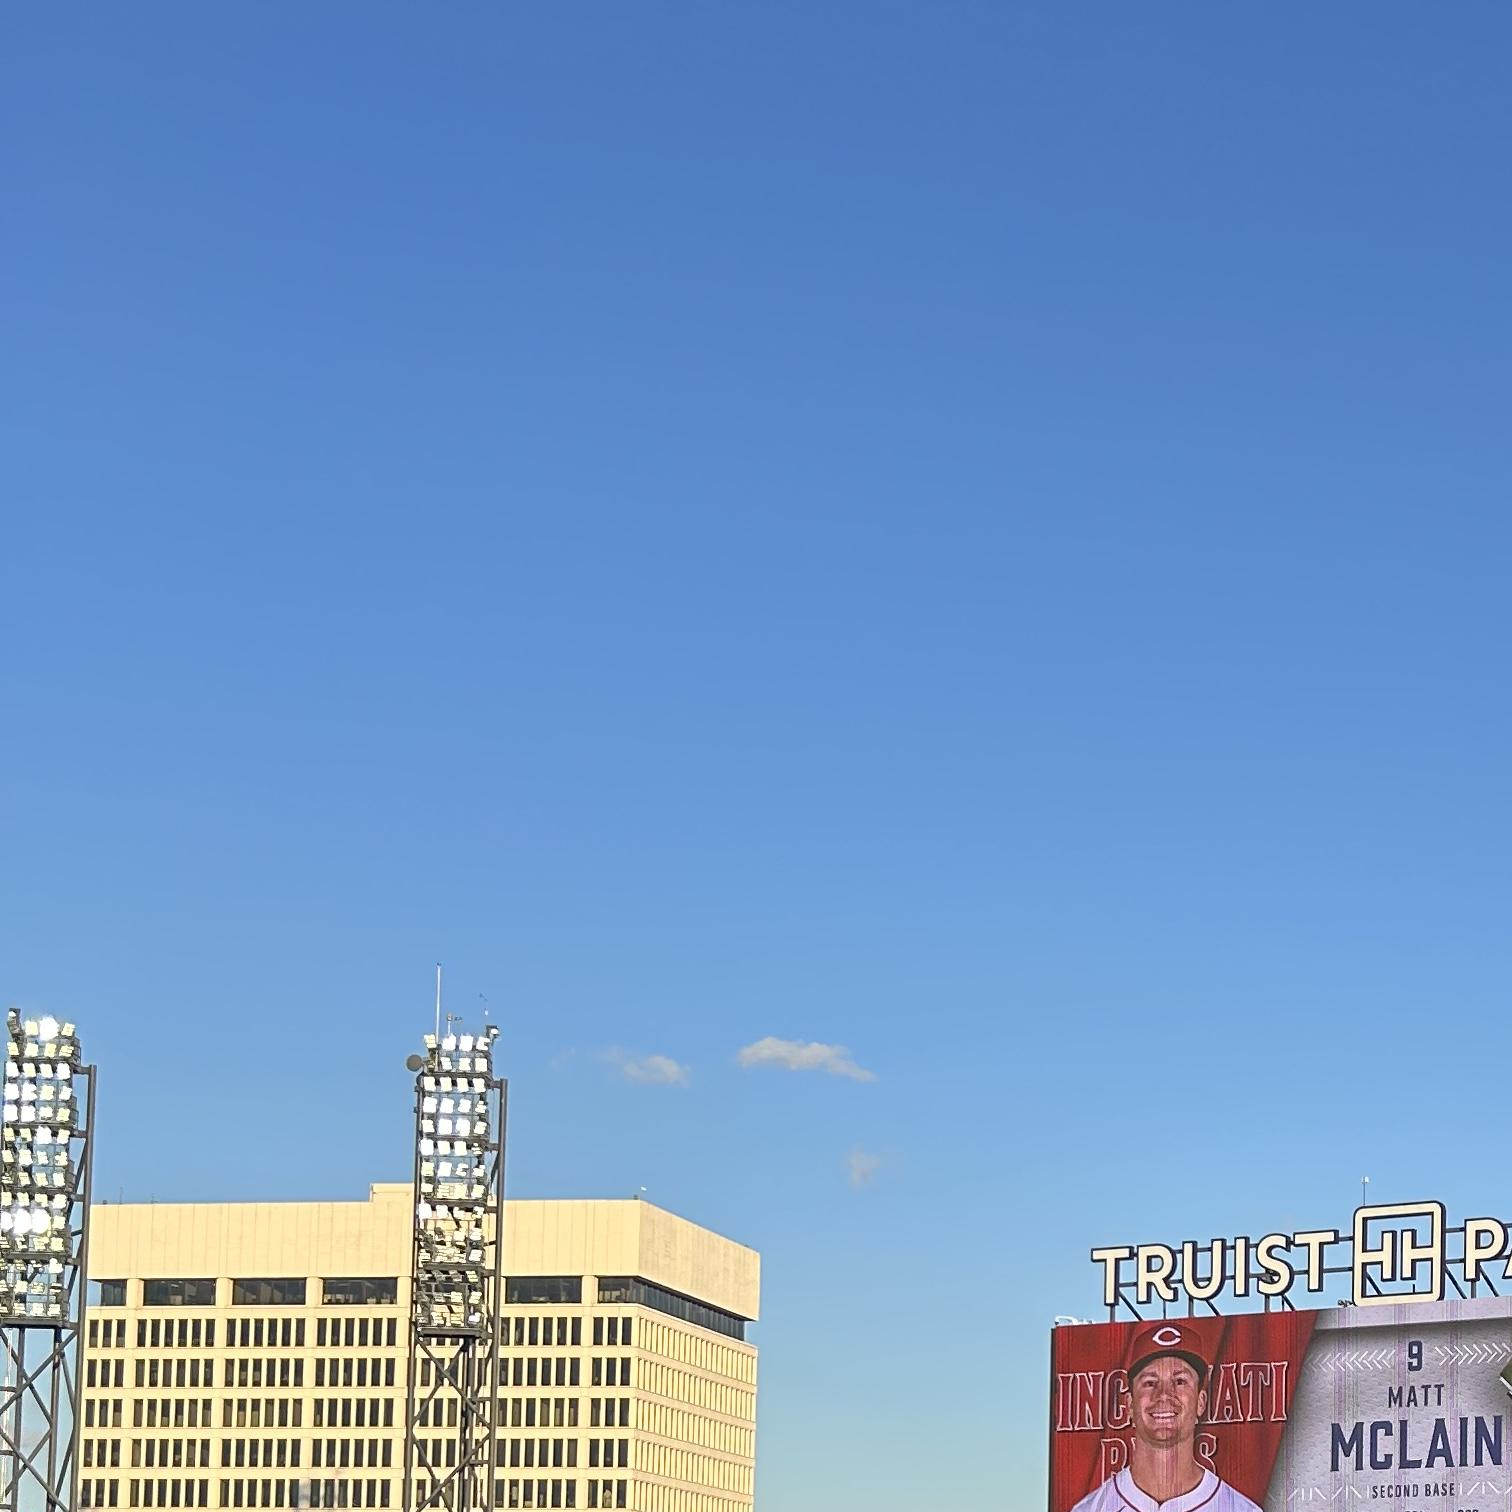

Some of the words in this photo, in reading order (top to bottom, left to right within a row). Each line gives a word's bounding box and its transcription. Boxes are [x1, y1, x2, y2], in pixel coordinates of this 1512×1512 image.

[1091, 1229, 1339, 1306] TRUIST
[1407, 1340, 1423, 1371] 9
[1388, 1384, 1445, 1408] MATT
[1330, 1415, 1503, 1472] MCLAIN
[1372, 1483, 1419, 1499] SECOND
[1425, 1482, 1456, 1497] BASE
